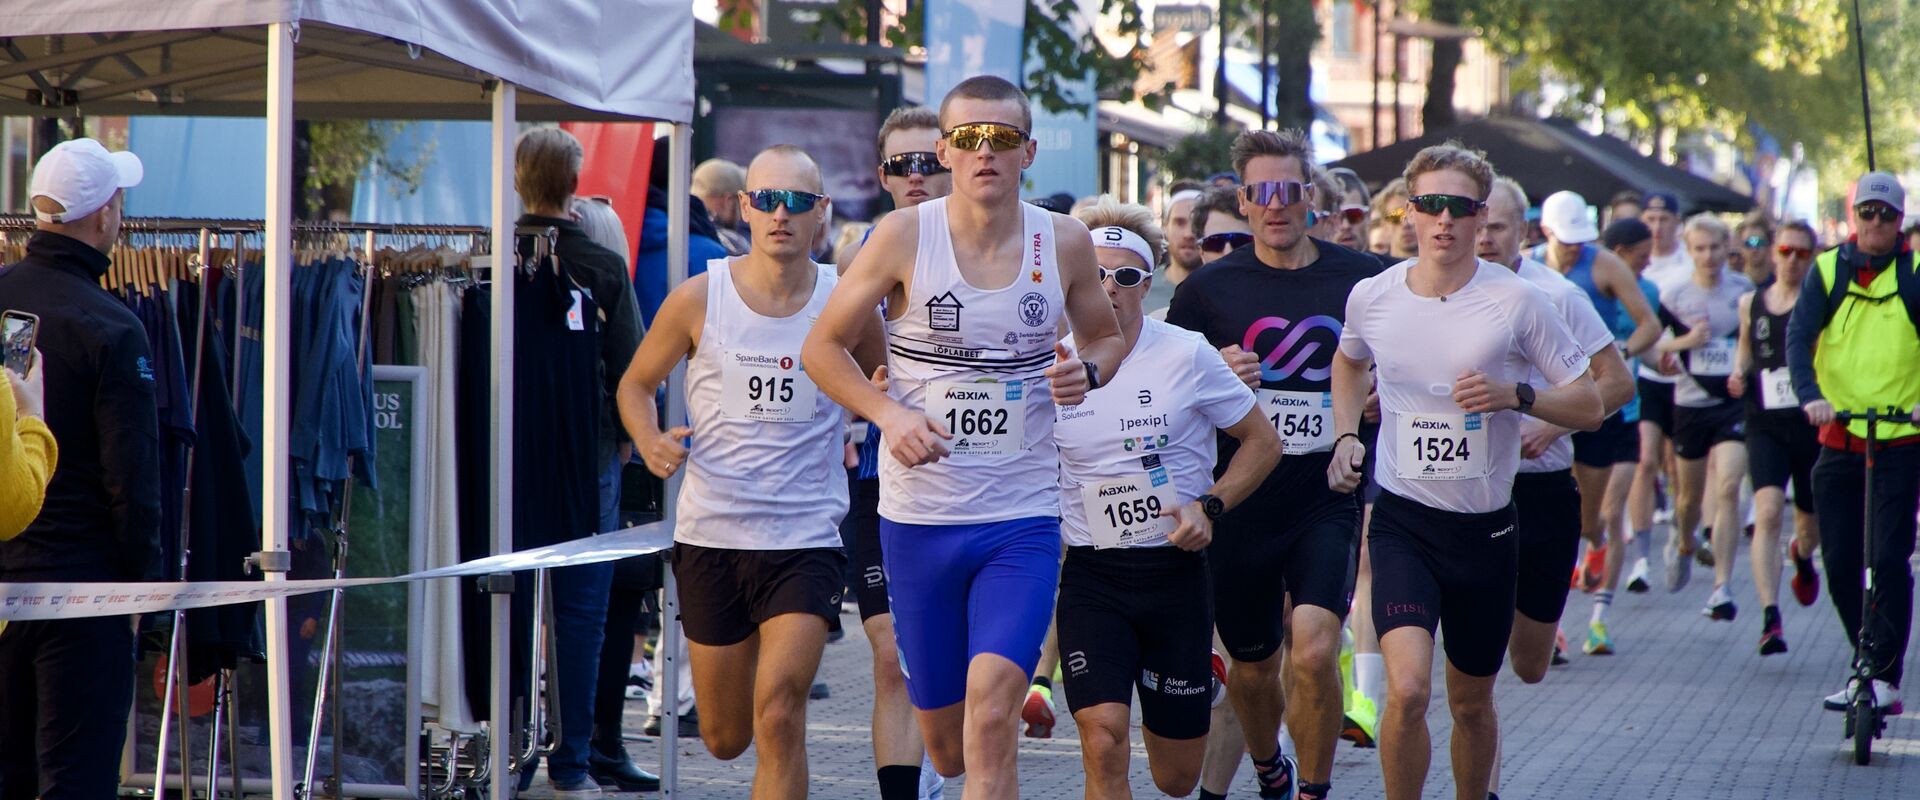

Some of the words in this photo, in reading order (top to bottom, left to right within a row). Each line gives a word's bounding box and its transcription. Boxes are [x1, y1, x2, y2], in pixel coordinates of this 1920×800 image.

[1033, 233, 1041, 266] EXTRA
[736, 353, 779, 364] SpareBank
[749, 376, 794, 403] 915
[945, 408, 1008, 435] 1662
[1062, 409, 1095, 421] Solutions
[1270, 412, 1323, 438] 1543
[1413, 436, 1470, 462] 1524
[1104, 495, 1162, 528] 1659
[1164, 685, 1206, 696] Solutions
[1165, 677, 1188, 687] Aker
